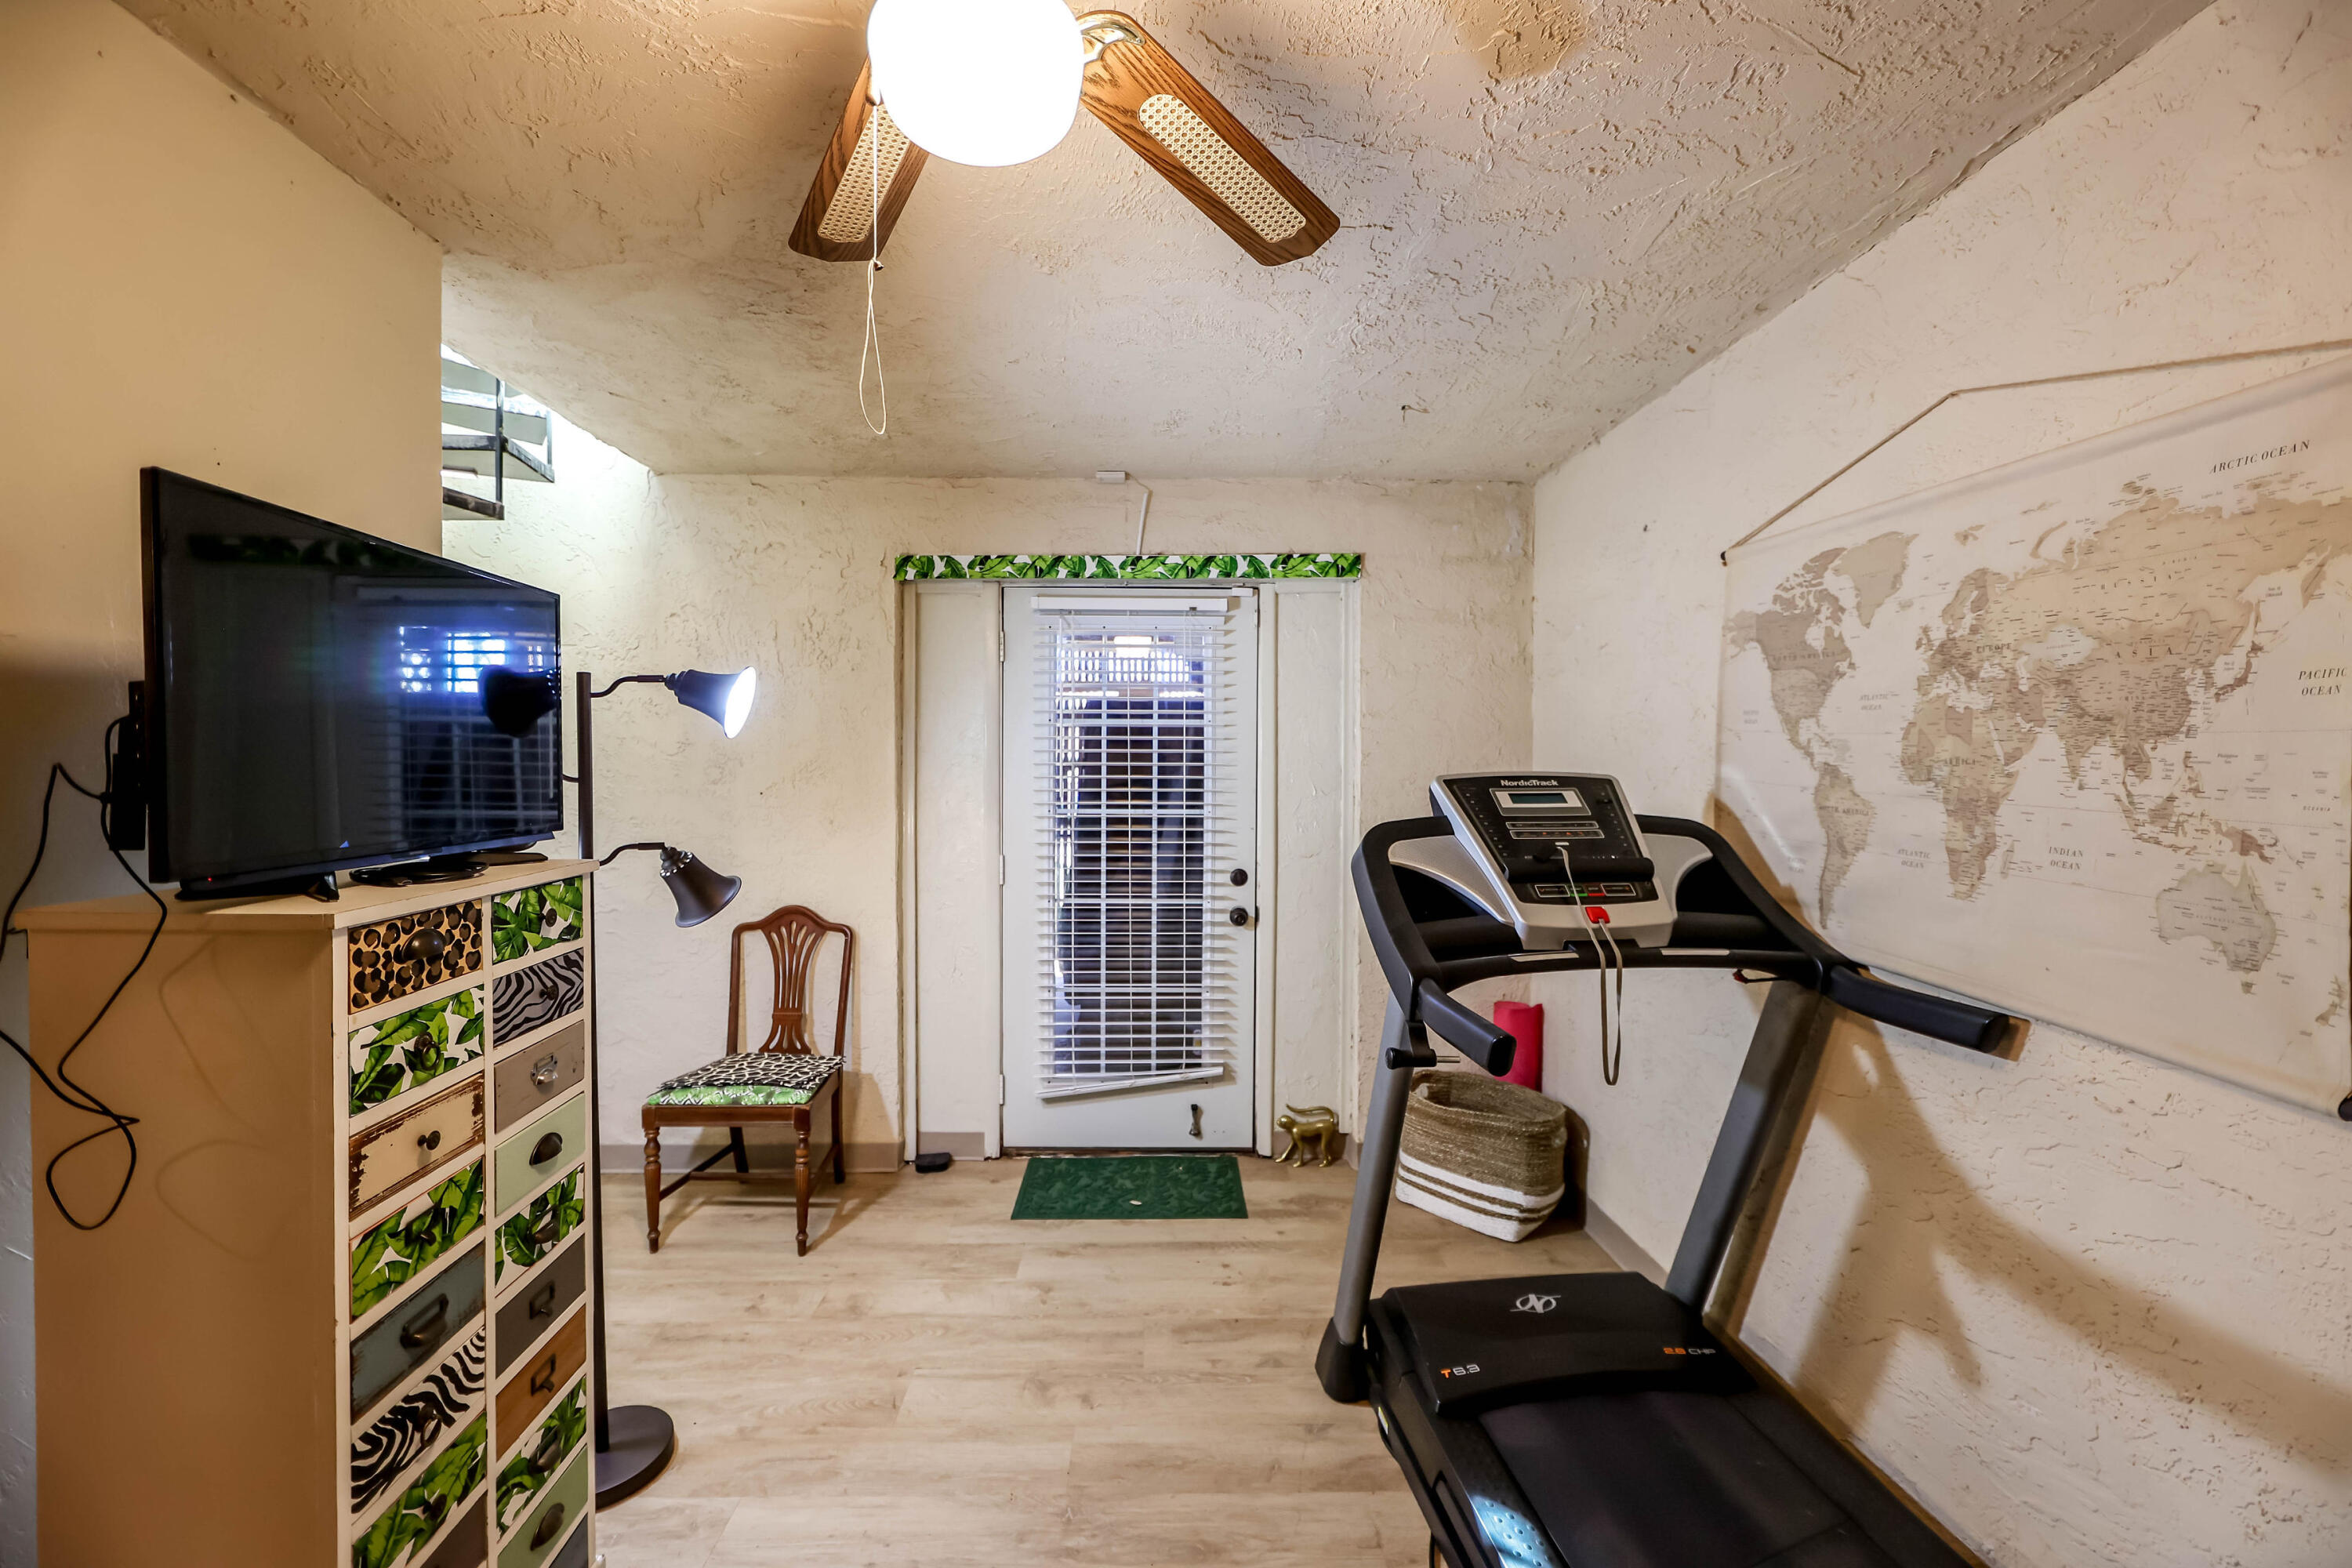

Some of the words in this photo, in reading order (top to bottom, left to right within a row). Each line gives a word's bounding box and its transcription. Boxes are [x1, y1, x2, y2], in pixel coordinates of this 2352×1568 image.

[2209, 454, 2258, 474] ARCTIC
[2261, 440, 2311, 460] OCEAN
[2117, 647, 2172, 659] ASIA
[2298, 667, 2347, 681] PACIFIC
[2301, 684, 2343, 696] OCEAN
[1897, 849, 1931, 859] ATLANTIC
[2048, 846, 2084, 858] INDIAN
[1900, 860, 1925, 869] OCEAN
[2050, 860, 2082, 871] OCEAN
